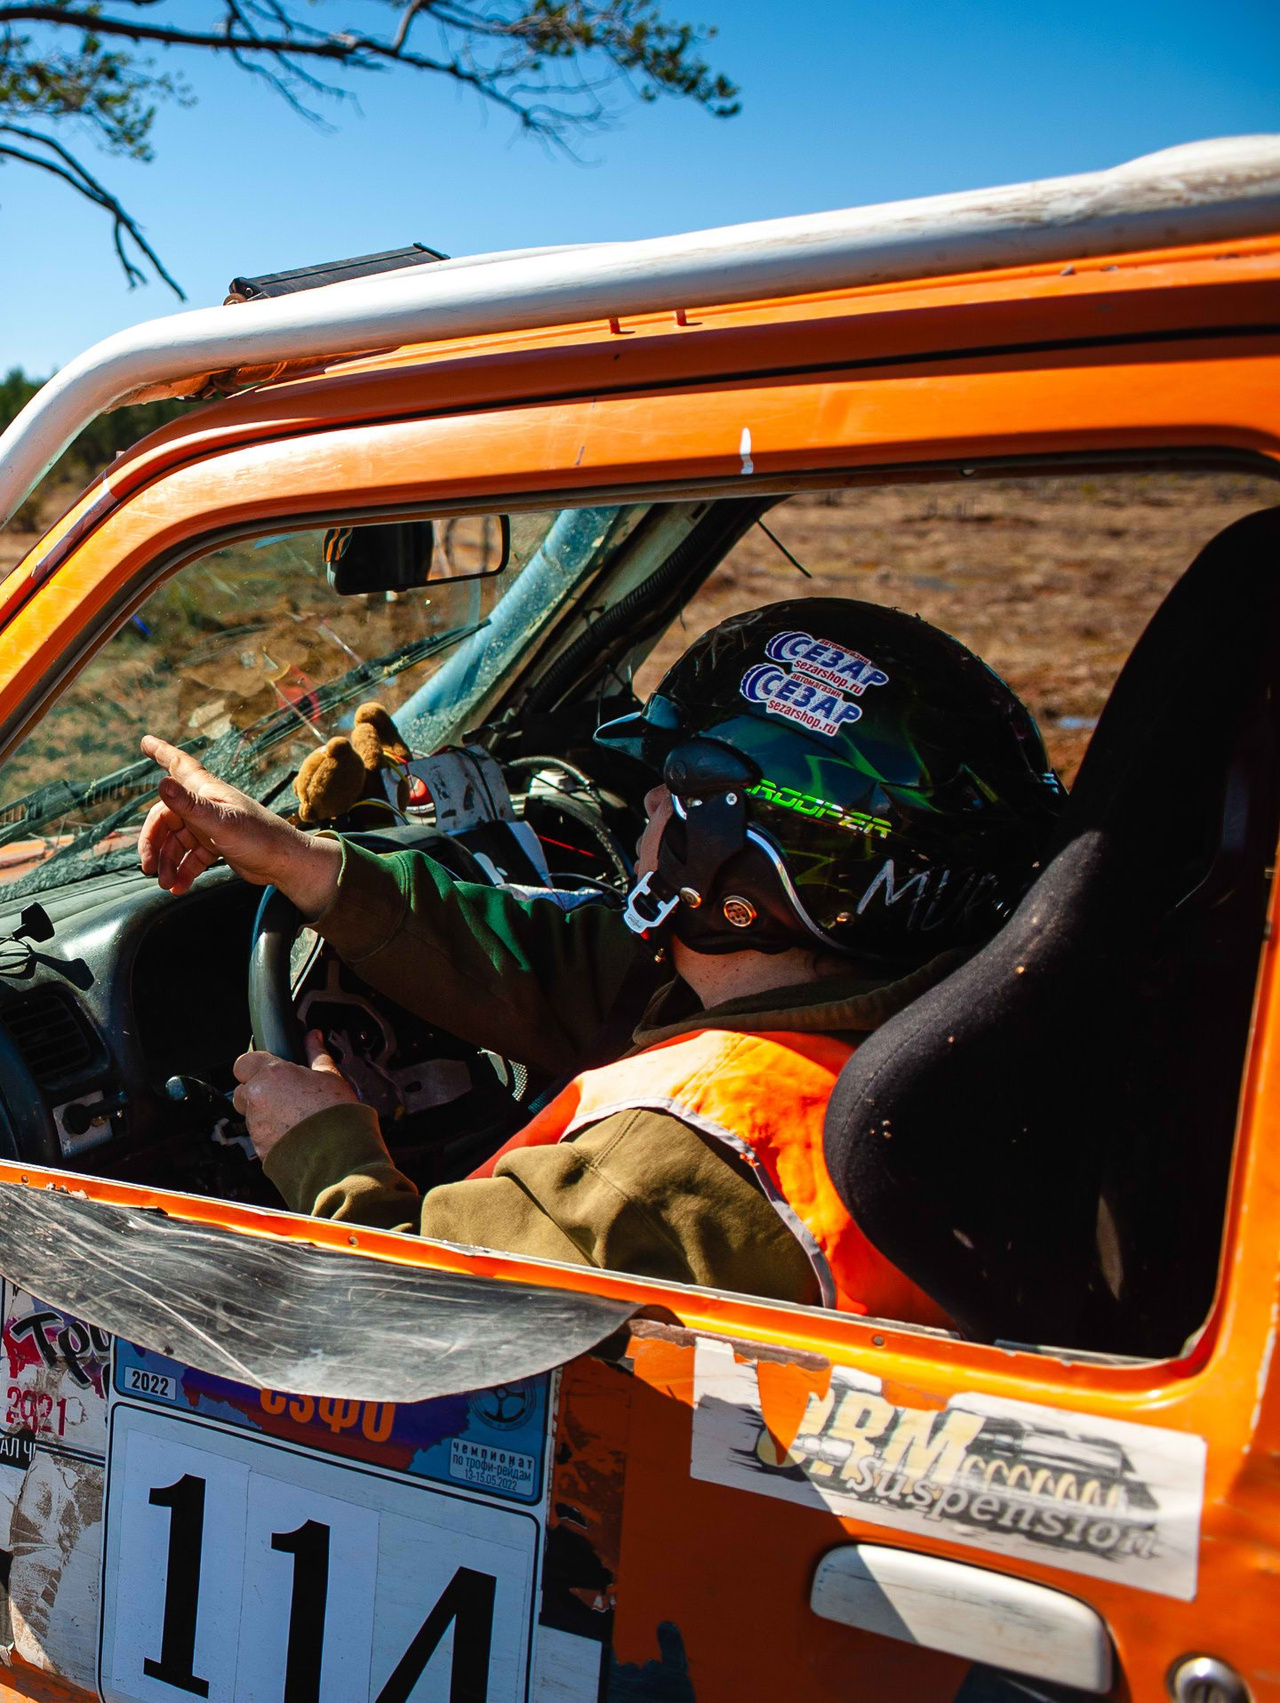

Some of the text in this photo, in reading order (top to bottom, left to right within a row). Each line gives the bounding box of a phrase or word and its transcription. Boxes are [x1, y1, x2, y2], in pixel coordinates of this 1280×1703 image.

[787, 638, 888, 686] СЕЗАР
[793, 659, 864, 696] sezarshop.ru
[761, 673, 861, 724] СЕЗАР
[790, 672, 843, 699] автомагазин
[767, 699, 837, 736] sezarshop.ru
[745, 778, 893, 839] ROOPER
[130, 1370, 169, 1397] 2022
[5, 1386, 67, 1437] 2021
[452, 1441, 533, 1470] чемпионат
[452, 1453, 532, 1482] по трофи-рейдам
[464, 1468, 518, 1492] 13-15.05.2022
